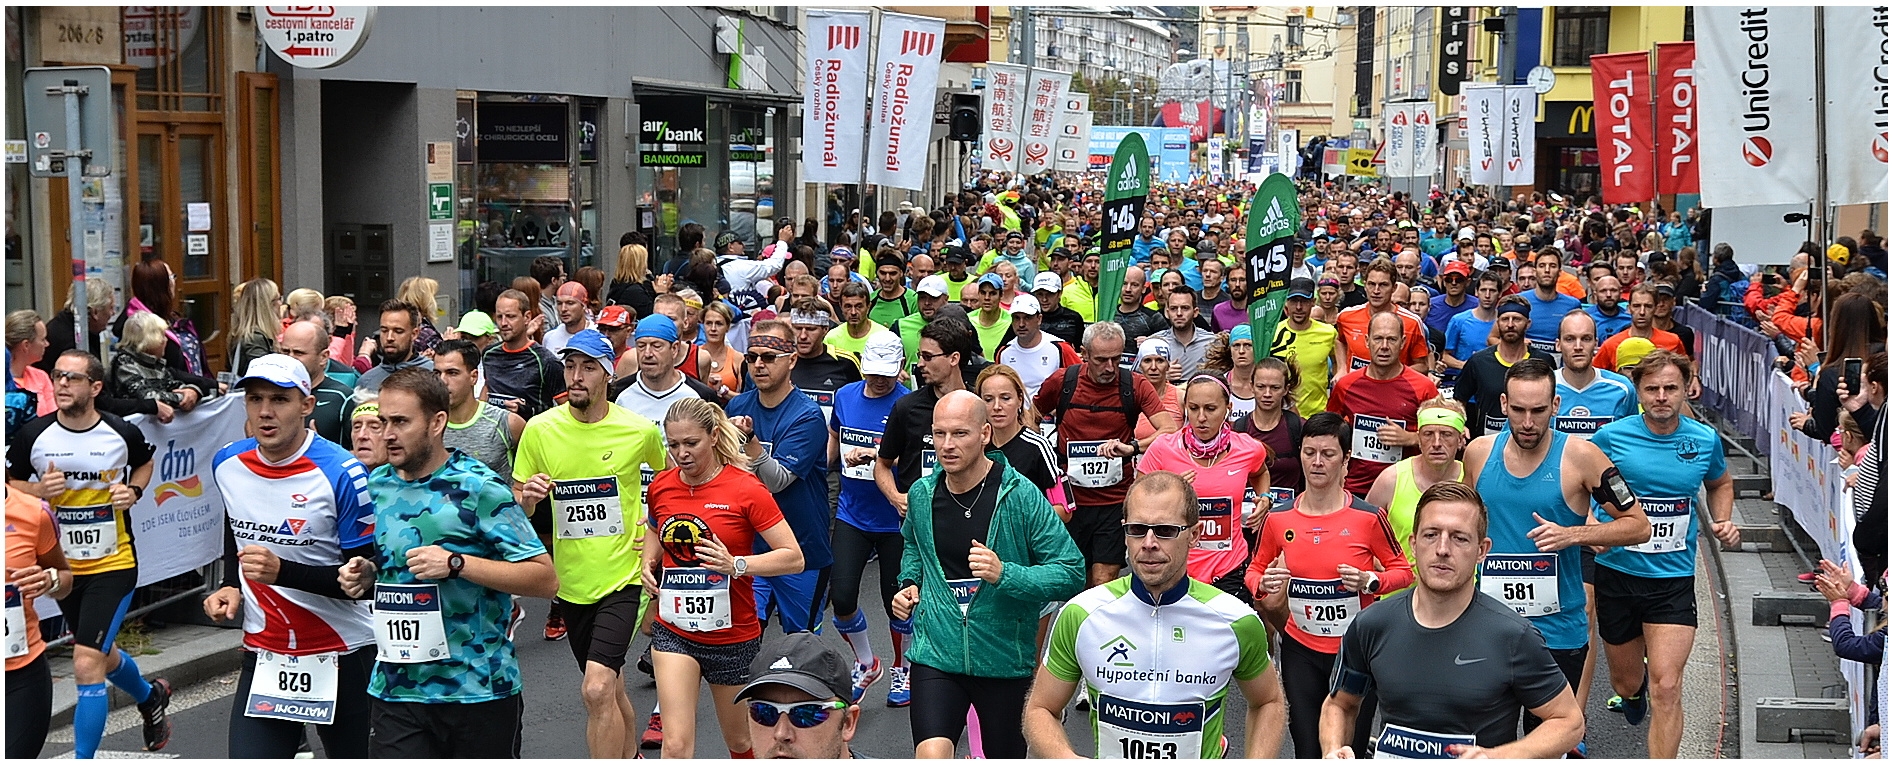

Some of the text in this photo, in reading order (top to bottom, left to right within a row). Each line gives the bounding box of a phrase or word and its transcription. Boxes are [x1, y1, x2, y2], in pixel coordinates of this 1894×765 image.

[265, 17, 355, 30] cestovní kancelář
[285, 30, 334, 44] 1.patro
[1740, 7, 1770, 132] UniCredit
[813, 89, 821, 121] rozhlas
[880, 91, 889, 124] rozhlas
[991, 71, 1008, 132] 海南航空
[1030, 77, 1052, 137] 海南航空
[823, 59, 841, 168] Radiožurnál
[886, 63, 914, 172] Radiožurnál
[1672, 60, 1697, 176] TOTAL
[483, 133, 535, 141] CHIRURGICKÉ
[506, 124, 541, 132] NEJLEPŠÍ
[1609, 70, 1633, 187] TOTAL
[643, 154, 703, 164] BANKOMAT
[1559, 420, 1597, 430] MATTONI
[842, 432, 873, 444] MATTONI
[160, 440, 195, 483] dm
[1081, 461, 1109, 476] 1327
[555, 483, 596, 495] MATTONI
[141, 505, 211, 533] ZDE JSEM ČLOVĚKEM
[565, 503, 607, 523] 2538
[66, 529, 101, 545] 1067
[178, 526, 192, 538] ZDE
[257, 536, 319, 546] BOLESLAV
[1486, 560, 1532, 571] MATTONI
[666, 574, 706, 584] MATTONI
[376, 591, 414, 605] MATTONI
[1292, 583, 1335, 595] MATTONI
[1503, 582, 1536, 601] 581
[674, 596, 715, 615] F 537
[1304, 604, 1347, 622] F 205
[386, 619, 420, 641] 1167
[1096, 666, 1217, 685] Hypoteční banka
[274, 703, 328, 718] MATTONI
[1105, 702, 1171, 725] MATTONI
[1119, 737, 1178, 760] 1053
[1383, 733, 1442, 756] MATTONI
